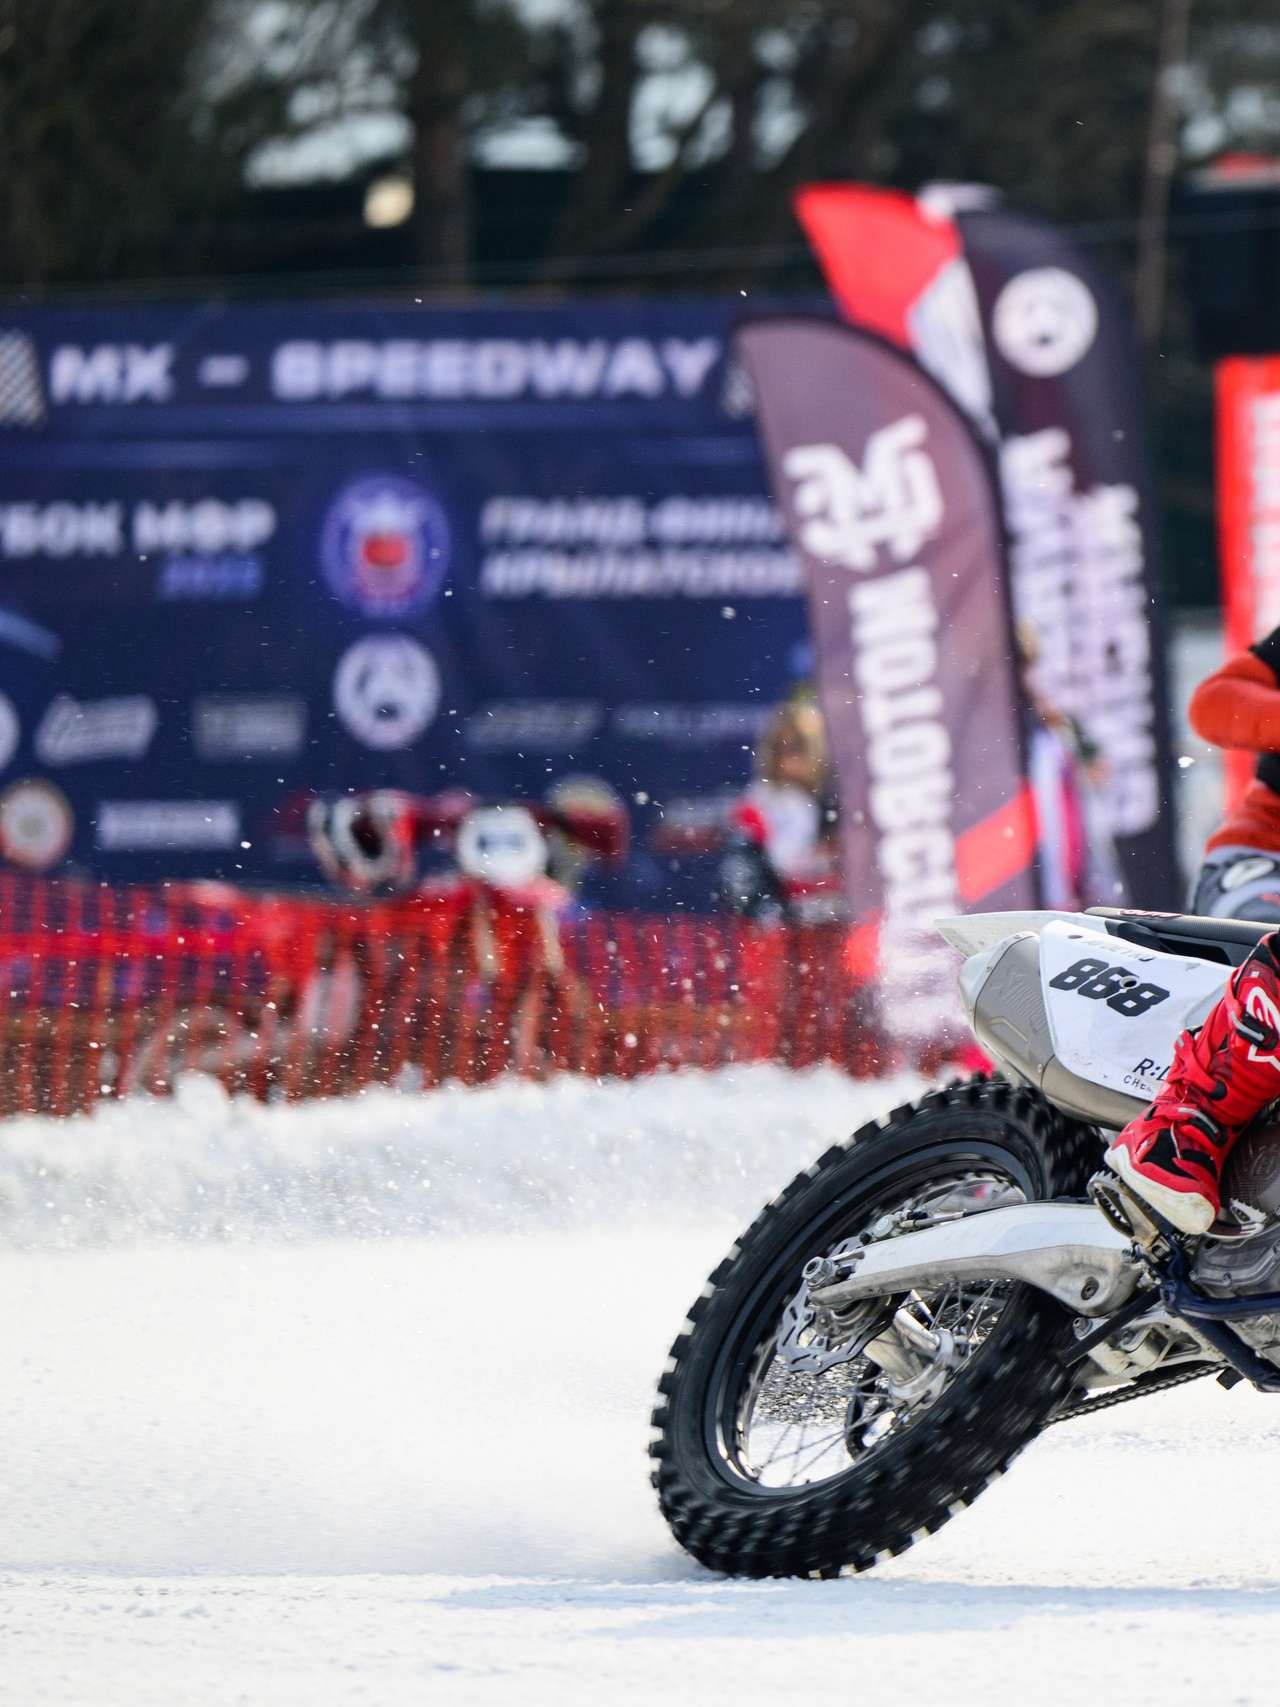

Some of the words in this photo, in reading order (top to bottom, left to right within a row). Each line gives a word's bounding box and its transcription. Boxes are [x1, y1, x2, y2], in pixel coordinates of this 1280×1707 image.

[49, 341, 176, 402] MX
[270, 338, 722, 402] SPEEDWAY
[1049, 957, 1171, 1017] 888
